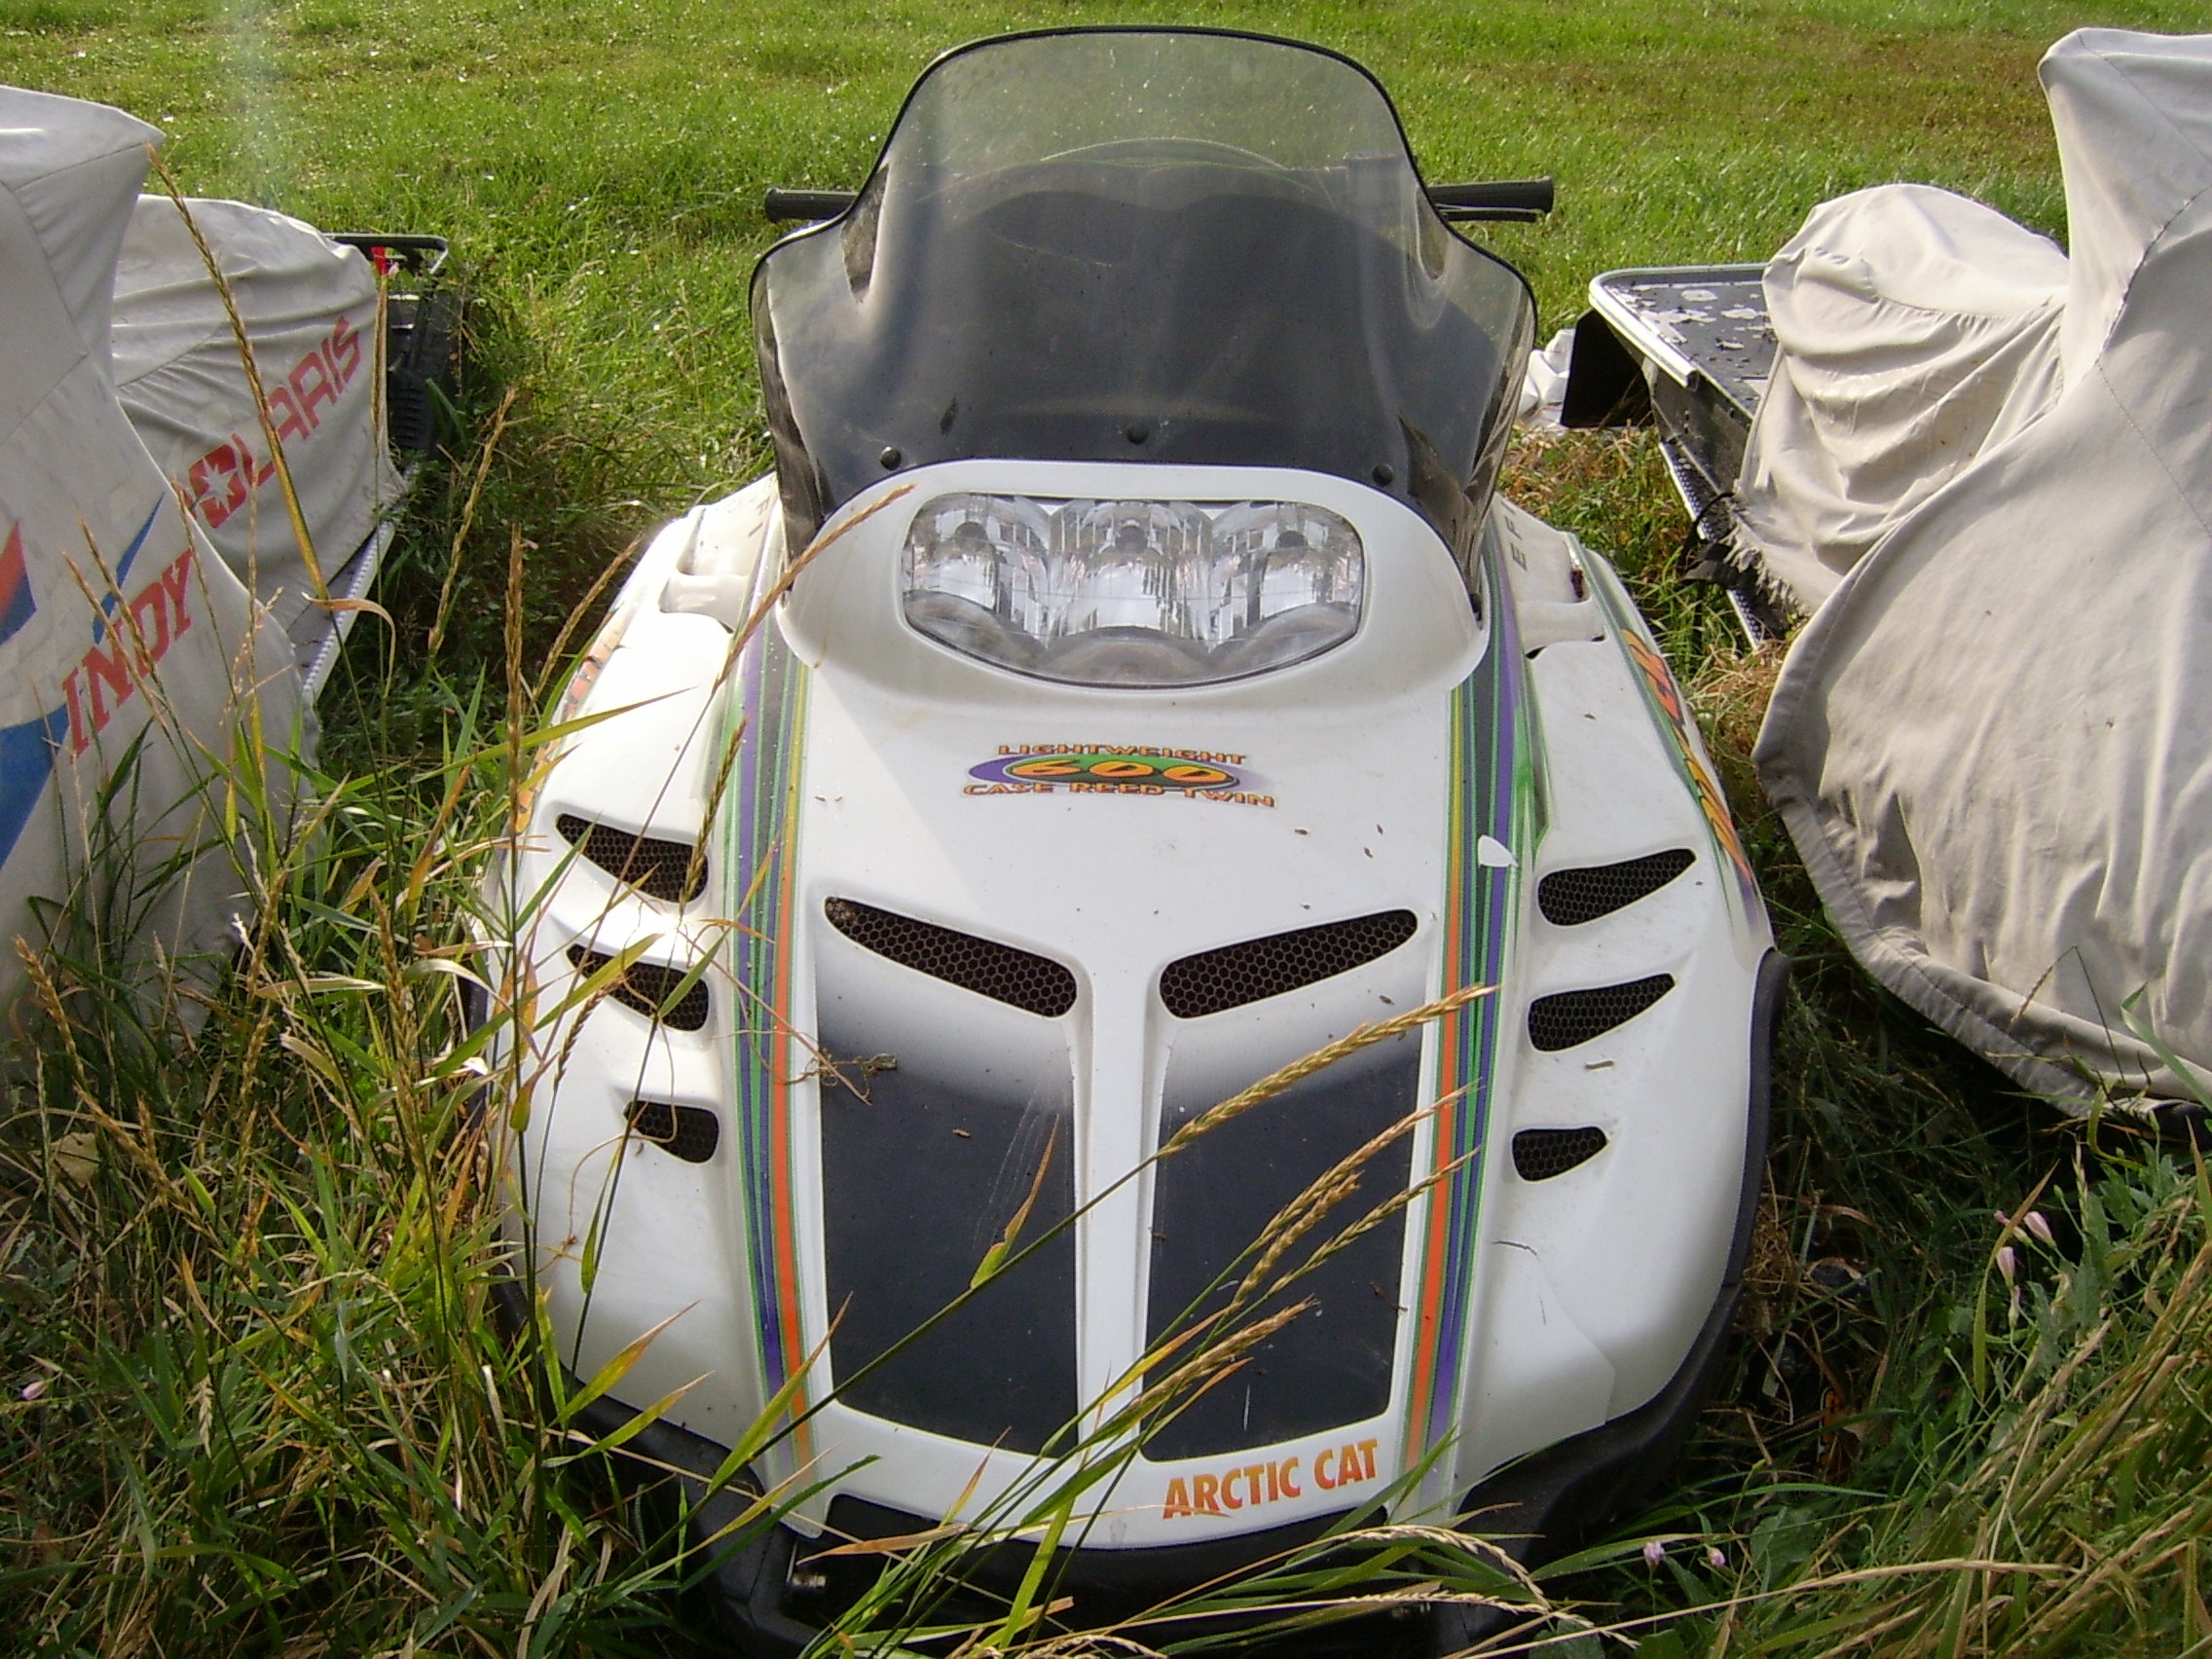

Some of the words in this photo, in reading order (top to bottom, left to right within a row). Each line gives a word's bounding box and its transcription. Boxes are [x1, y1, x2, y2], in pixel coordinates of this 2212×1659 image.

[179, 314, 361, 529] OLARIS
[61, 547, 194, 763] INDY
[997, 743, 1247, 765] LIGHTWEIGHT
[1010, 758, 1230, 784] 600
[963, 782, 1054, 796] CASE
[1068, 782, 1165, 796] REED
[1183, 788, 1275, 808] TWIN
[1161, 1456, 1302, 1520] ARCTIC
[1313, 1437, 1379, 1491] CAT
